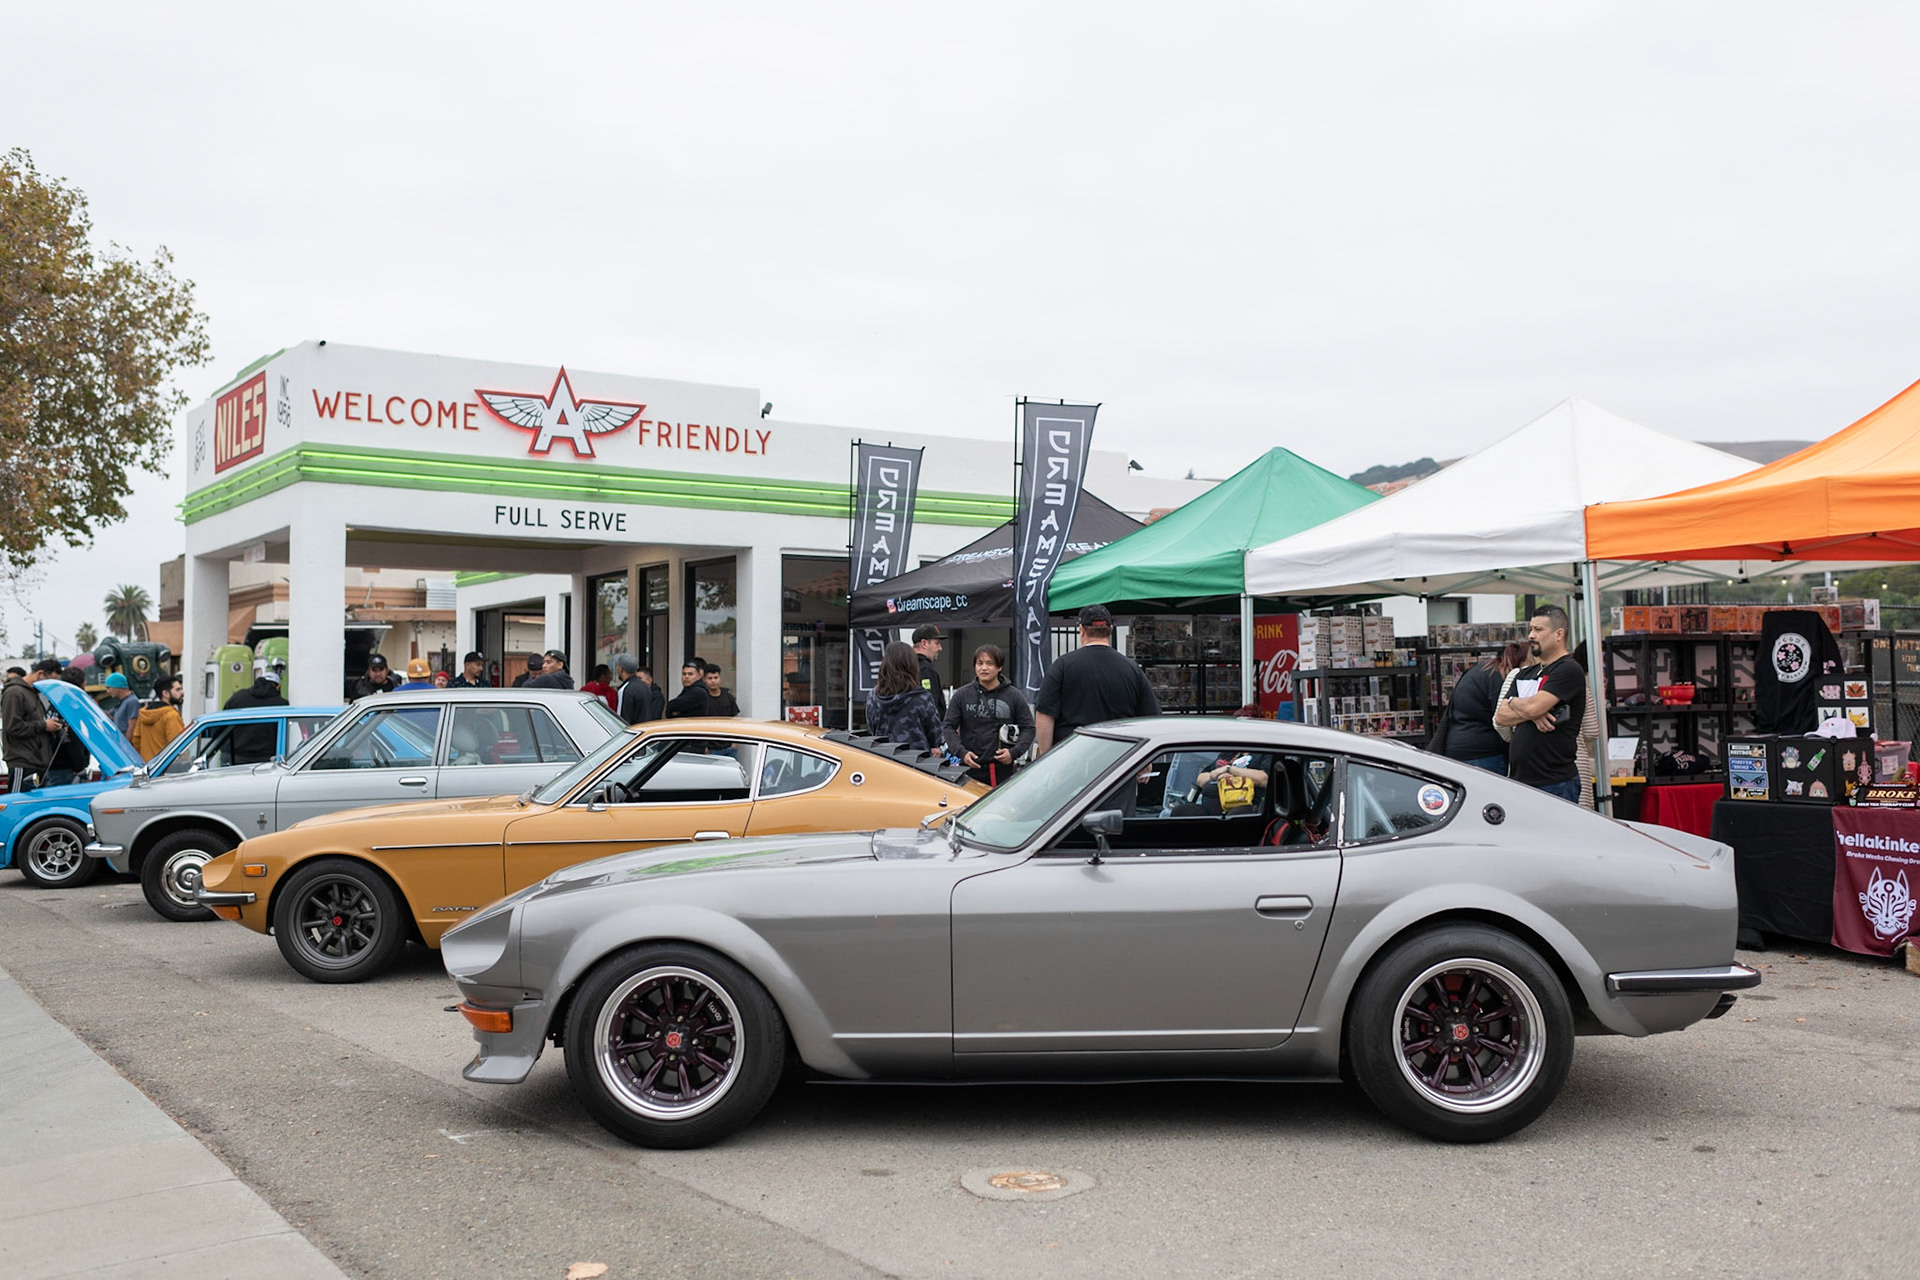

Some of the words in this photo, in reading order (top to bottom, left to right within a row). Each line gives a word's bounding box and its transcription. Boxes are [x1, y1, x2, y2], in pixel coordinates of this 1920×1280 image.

[216, 379, 265, 467] NILES
[312, 388, 480, 432] WELCOME
[638, 419, 772, 456] FRIENDLY
[495, 505, 548, 528] FULL
[560, 509, 627, 532] SERVE
[896, 594, 968, 613] dreamscape_cc
[1866, 789, 1917, 799] BROKE
[1836, 830, 1920, 854] hellakinke
